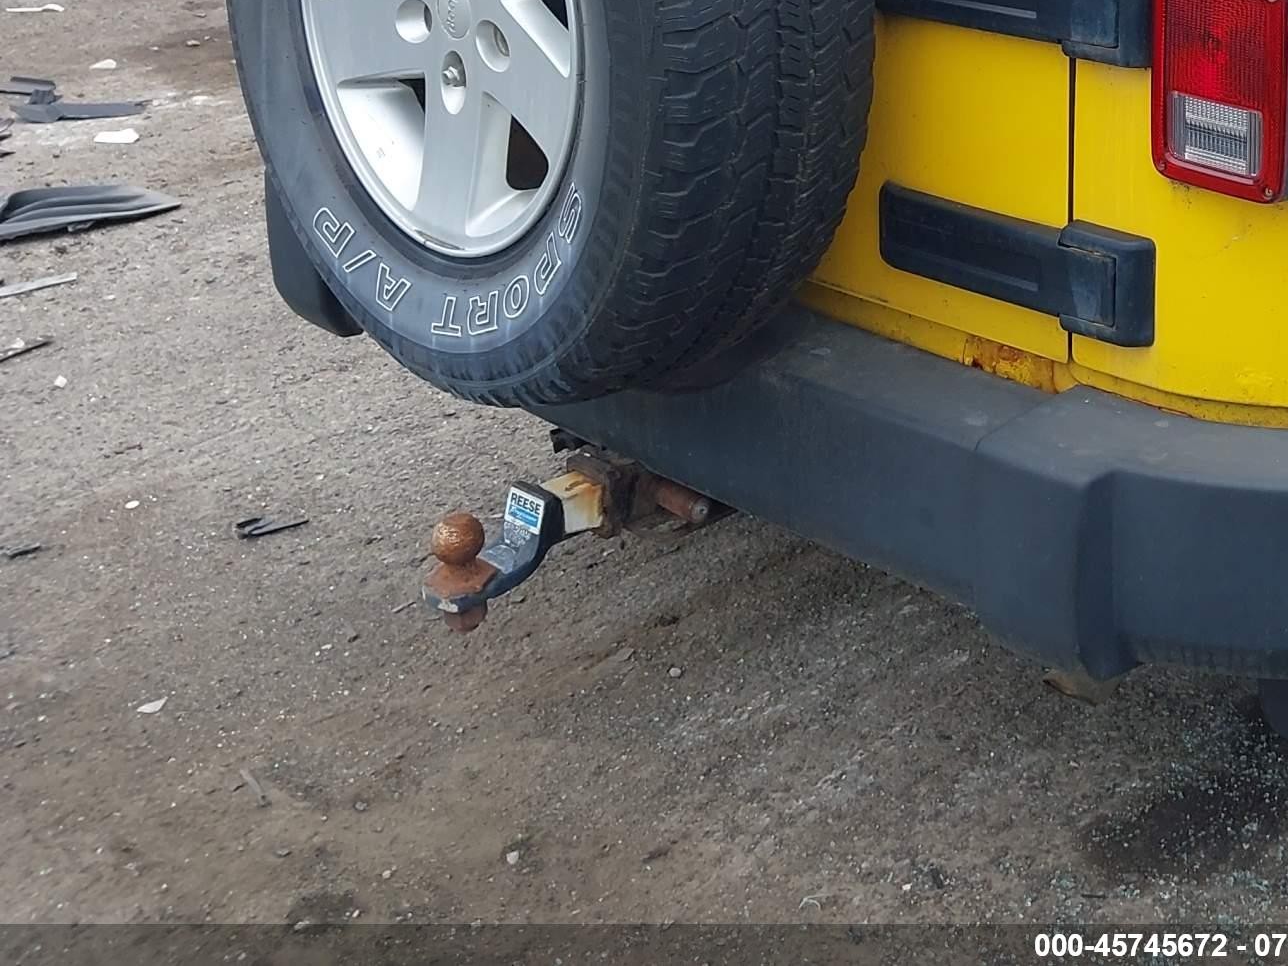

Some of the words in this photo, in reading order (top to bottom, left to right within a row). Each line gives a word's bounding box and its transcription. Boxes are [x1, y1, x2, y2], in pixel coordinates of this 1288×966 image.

[312, 206, 412, 311] A/P
[430, 182, 582, 337] SPORT
[510, 492, 542, 516] REESE
